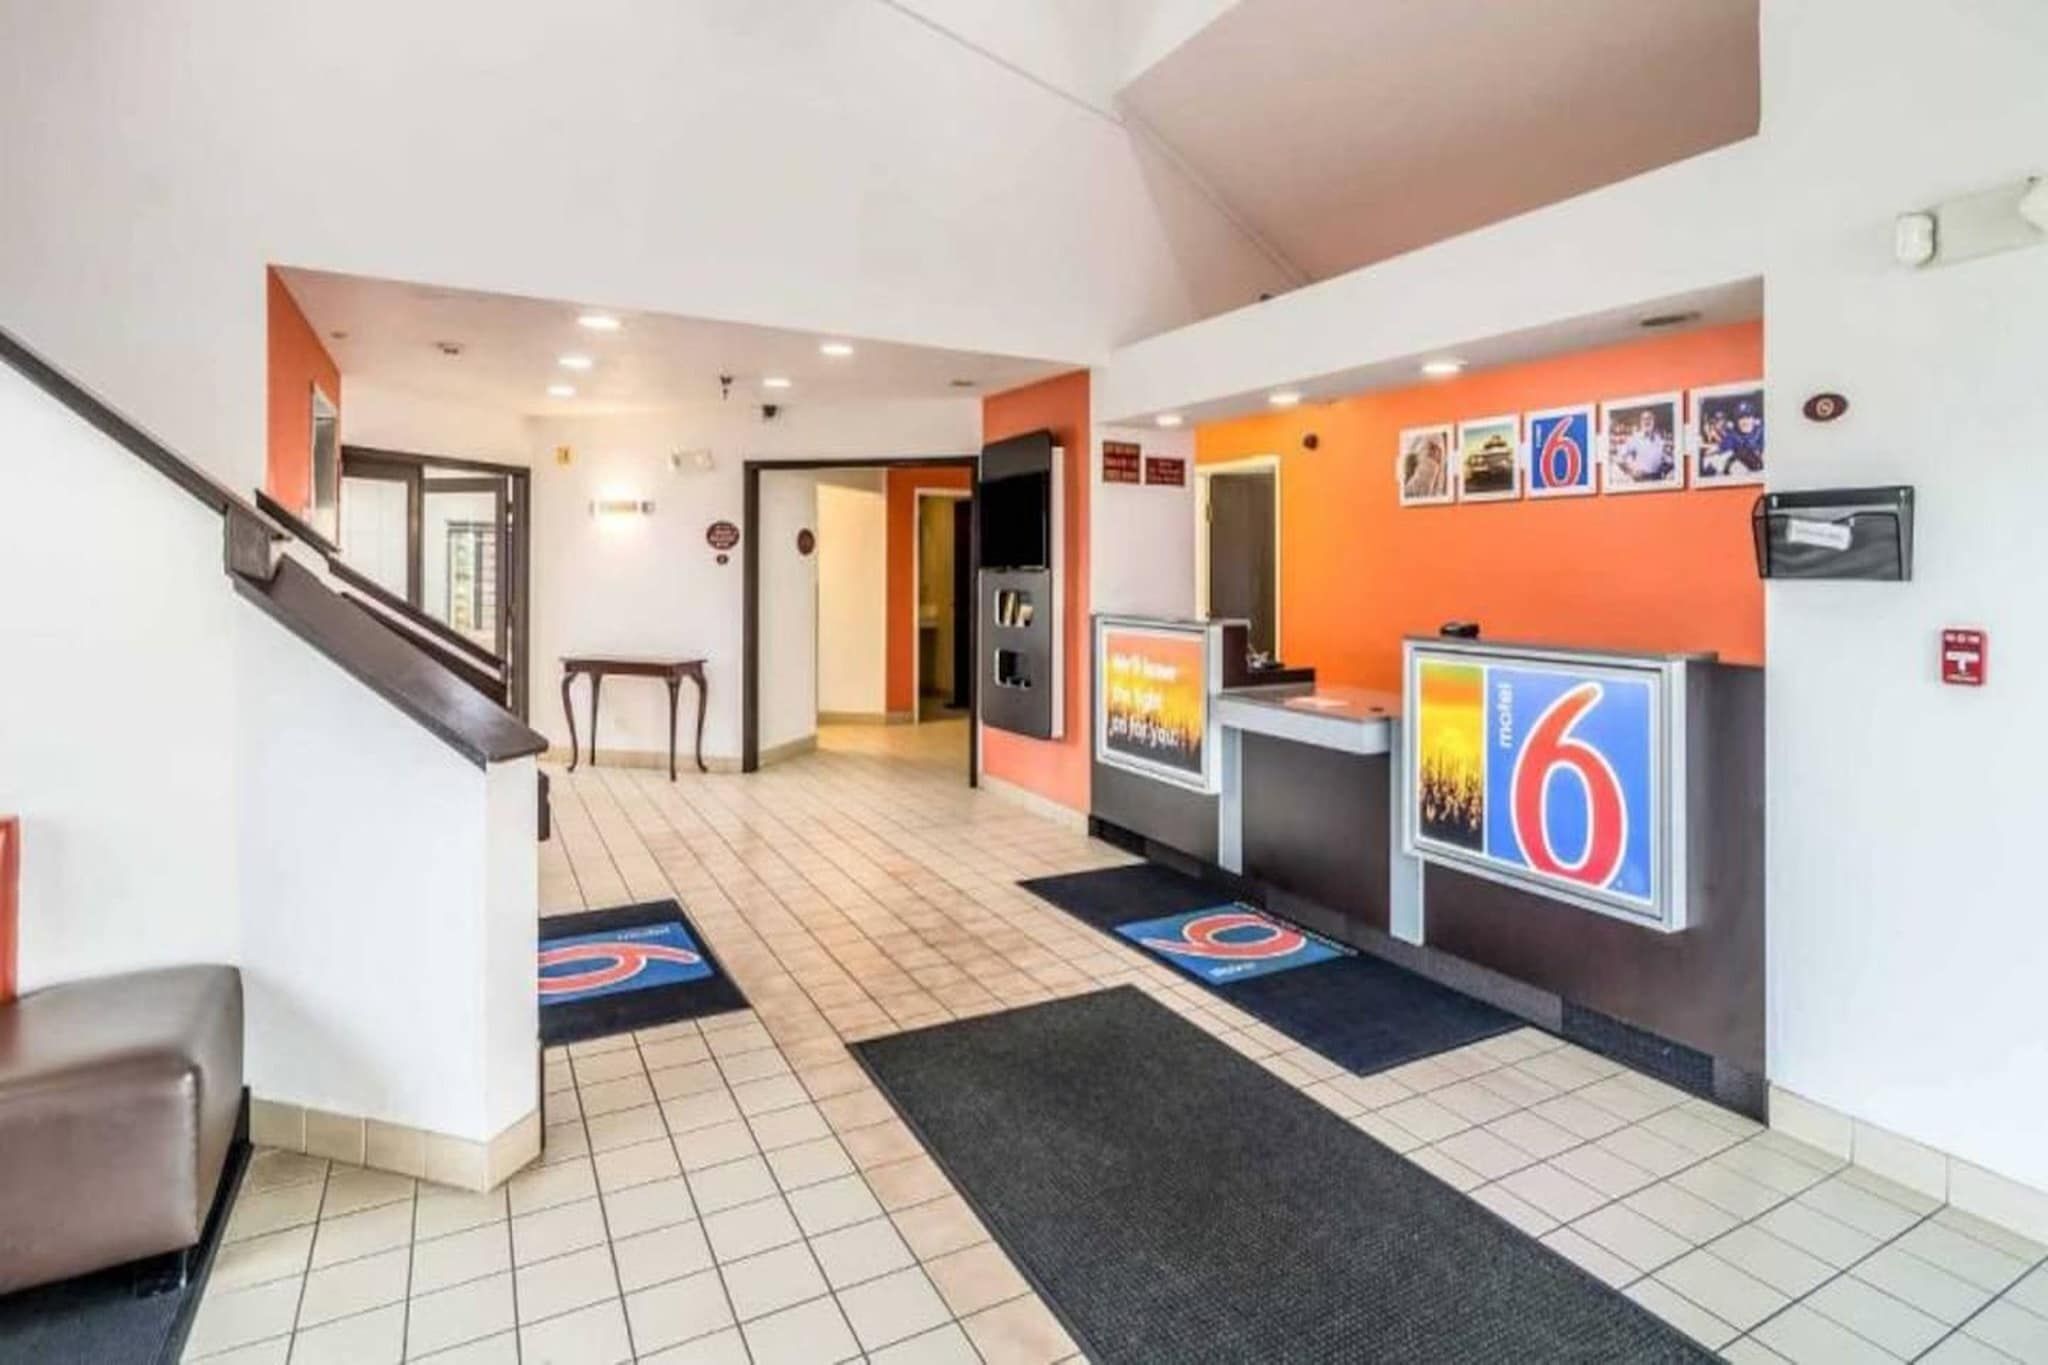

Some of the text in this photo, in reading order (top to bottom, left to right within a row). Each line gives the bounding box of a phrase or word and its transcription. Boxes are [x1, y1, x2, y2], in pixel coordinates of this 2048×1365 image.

[1539, 415, 1582, 488] 6
[1128, 715, 1147, 742] for
[1498, 681, 1629, 891] motel 6
[1139, 913, 1308, 961] 6
